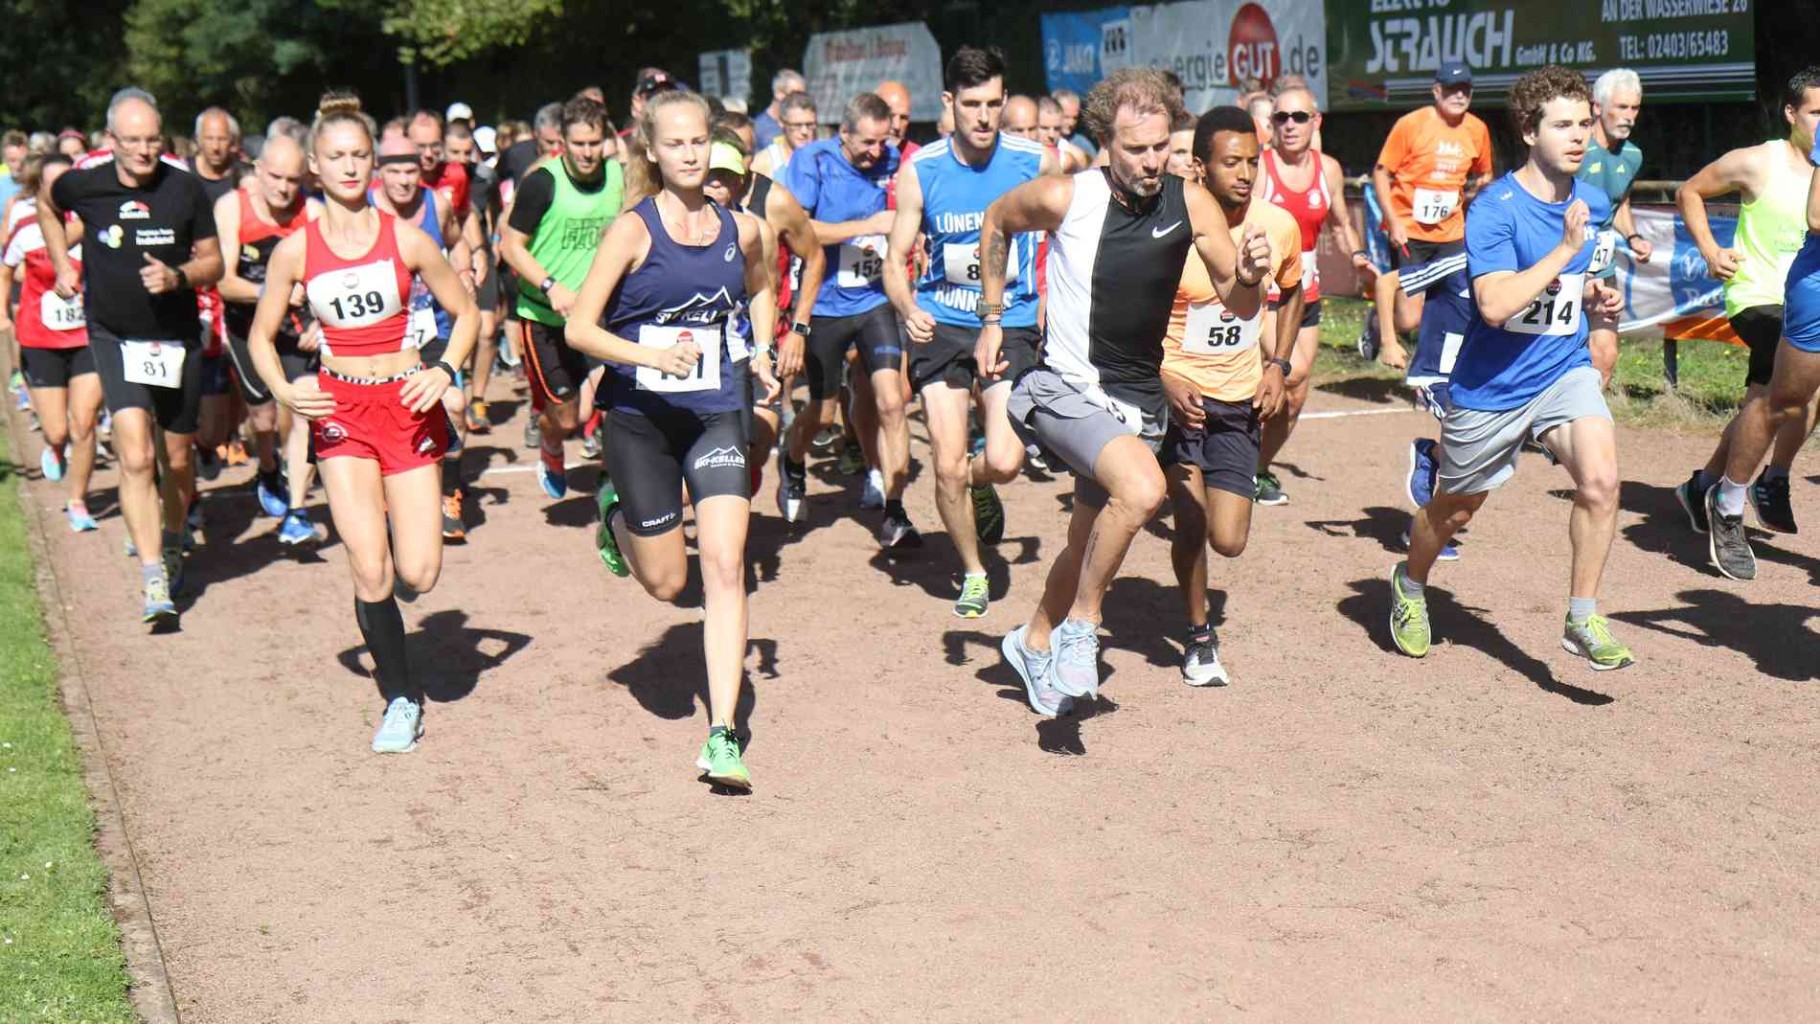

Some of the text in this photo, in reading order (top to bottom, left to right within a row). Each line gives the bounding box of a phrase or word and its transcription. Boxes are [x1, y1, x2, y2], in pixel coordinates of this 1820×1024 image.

[1620, 0, 1642, 21] DER
[1366, 9, 1514, 73] STRAUCH
[1620, 30, 1729, 60] TEL: 02403/65483
[1516, 44, 1547, 65] GmbH
[1549, 43, 1557, 63] &
[1560, 42, 1575, 64] Co
[1422, 205, 1449, 219] 176
[851, 260, 883, 279] 152
[329, 290, 385, 320] 139
[1522, 300, 1573, 325] 214
[1207, 325, 1242, 347] 58
[143, 360, 167, 378] 81
[641, 514, 670, 528] CRAFT
